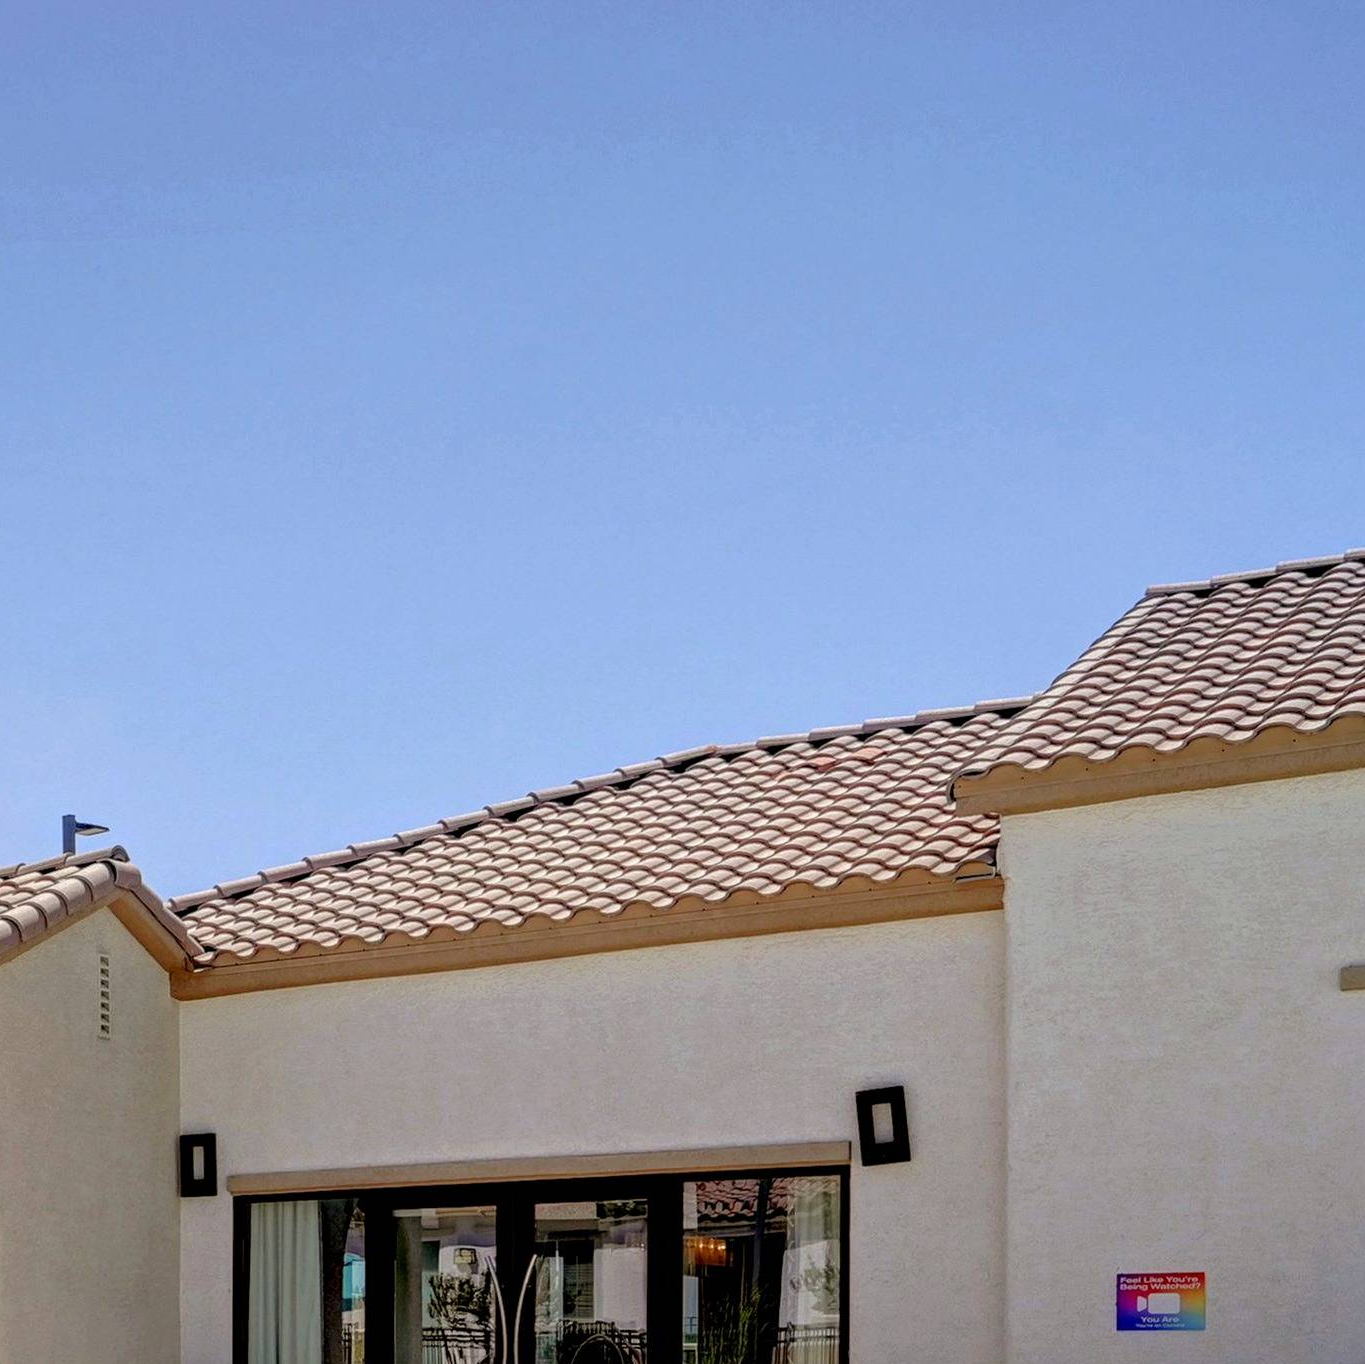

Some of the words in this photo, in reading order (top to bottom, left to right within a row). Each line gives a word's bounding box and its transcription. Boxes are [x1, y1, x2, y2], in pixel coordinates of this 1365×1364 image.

[1120, 1276, 1141, 1284] Feel
[1166, 1275, 1199, 1283] You're
[1120, 1283, 1148, 1291] Being
[1150, 1282, 1201, 1290] Watched?
